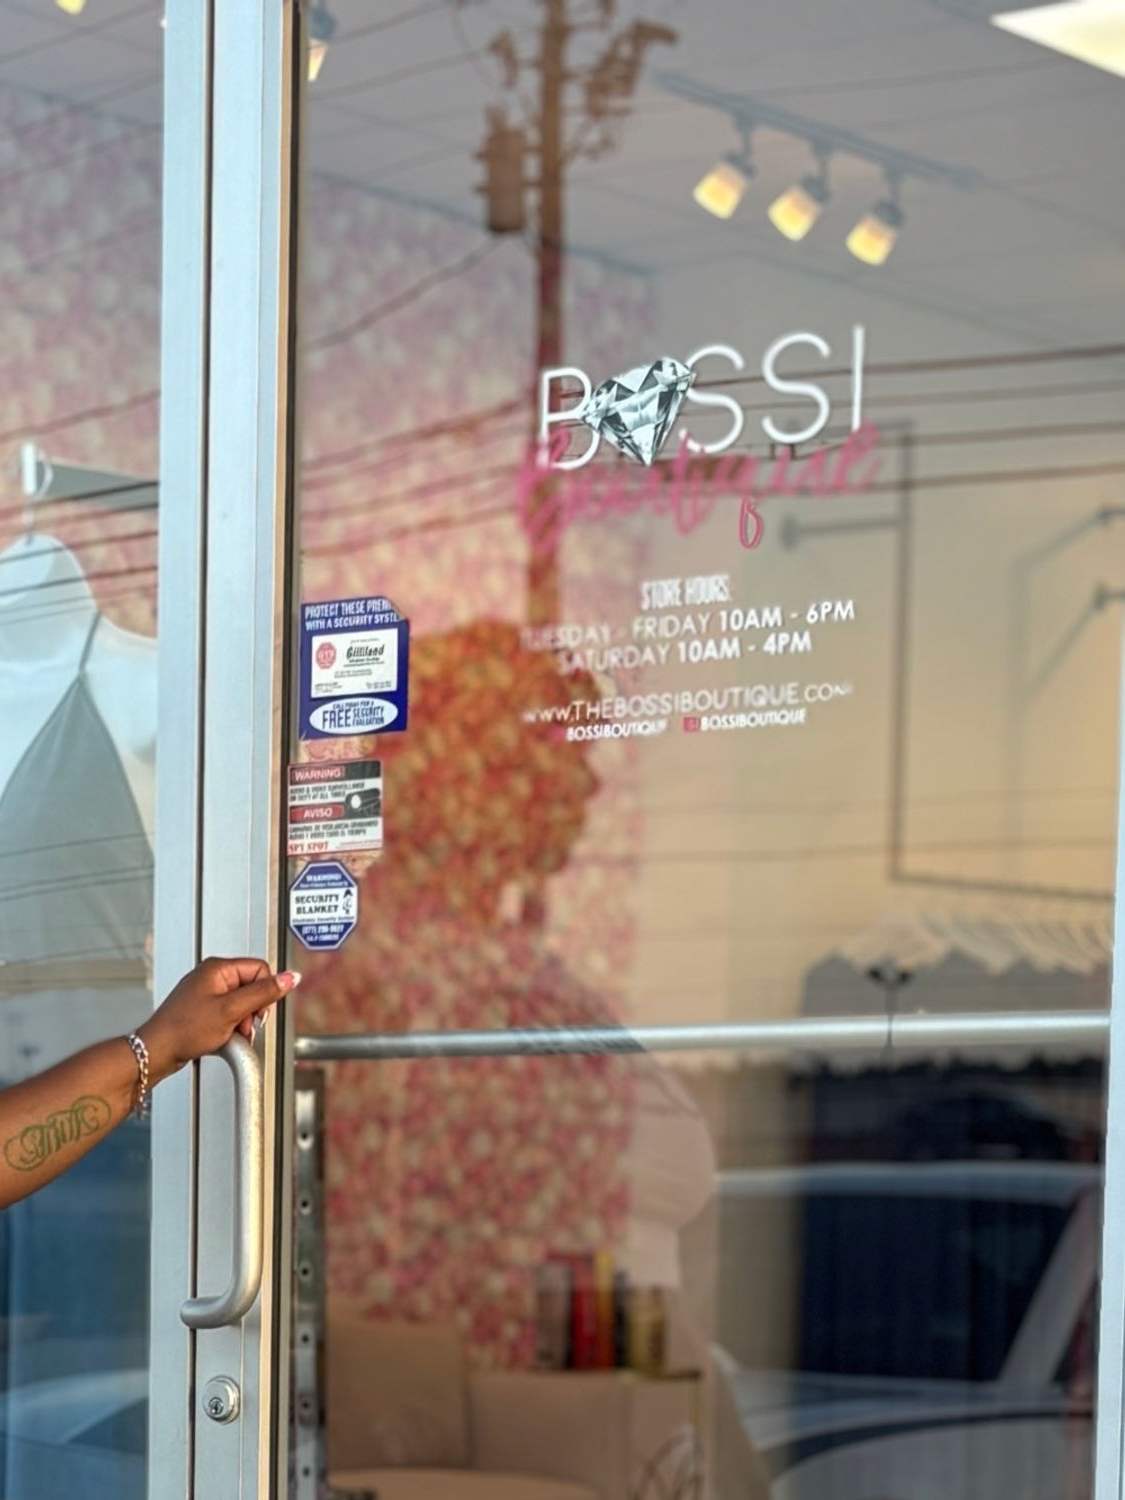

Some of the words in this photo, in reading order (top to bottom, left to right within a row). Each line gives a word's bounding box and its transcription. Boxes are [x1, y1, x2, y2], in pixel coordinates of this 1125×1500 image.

[641, 578, 682, 610] STORE
[305, 602, 339, 619] PROTECT
[341, 600, 365, 616] THESE
[305, 619, 325, 631] WITH
[326, 619, 332, 629] A
[335, 614, 373, 628] SECURITY
[633, 612, 710, 639] FRIDAY
[720, 606, 782, 632] 10AM
[807, 600, 855, 624] 6PM
[557, 643, 670, 676] SATURDAY
[678, 637, 740, 663] 10AM
[764, 630, 812, 655] 4PM
[322, 709, 351, 729] FREE
[701, 708, 805, 731] BOSSIBOUTIQUE
[295, 768, 341, 781] WARNING
[303, 808, 333, 818] AVISO
[295, 894, 339, 904] SECURITY
[296, 905, 339, 915] BLANKET
